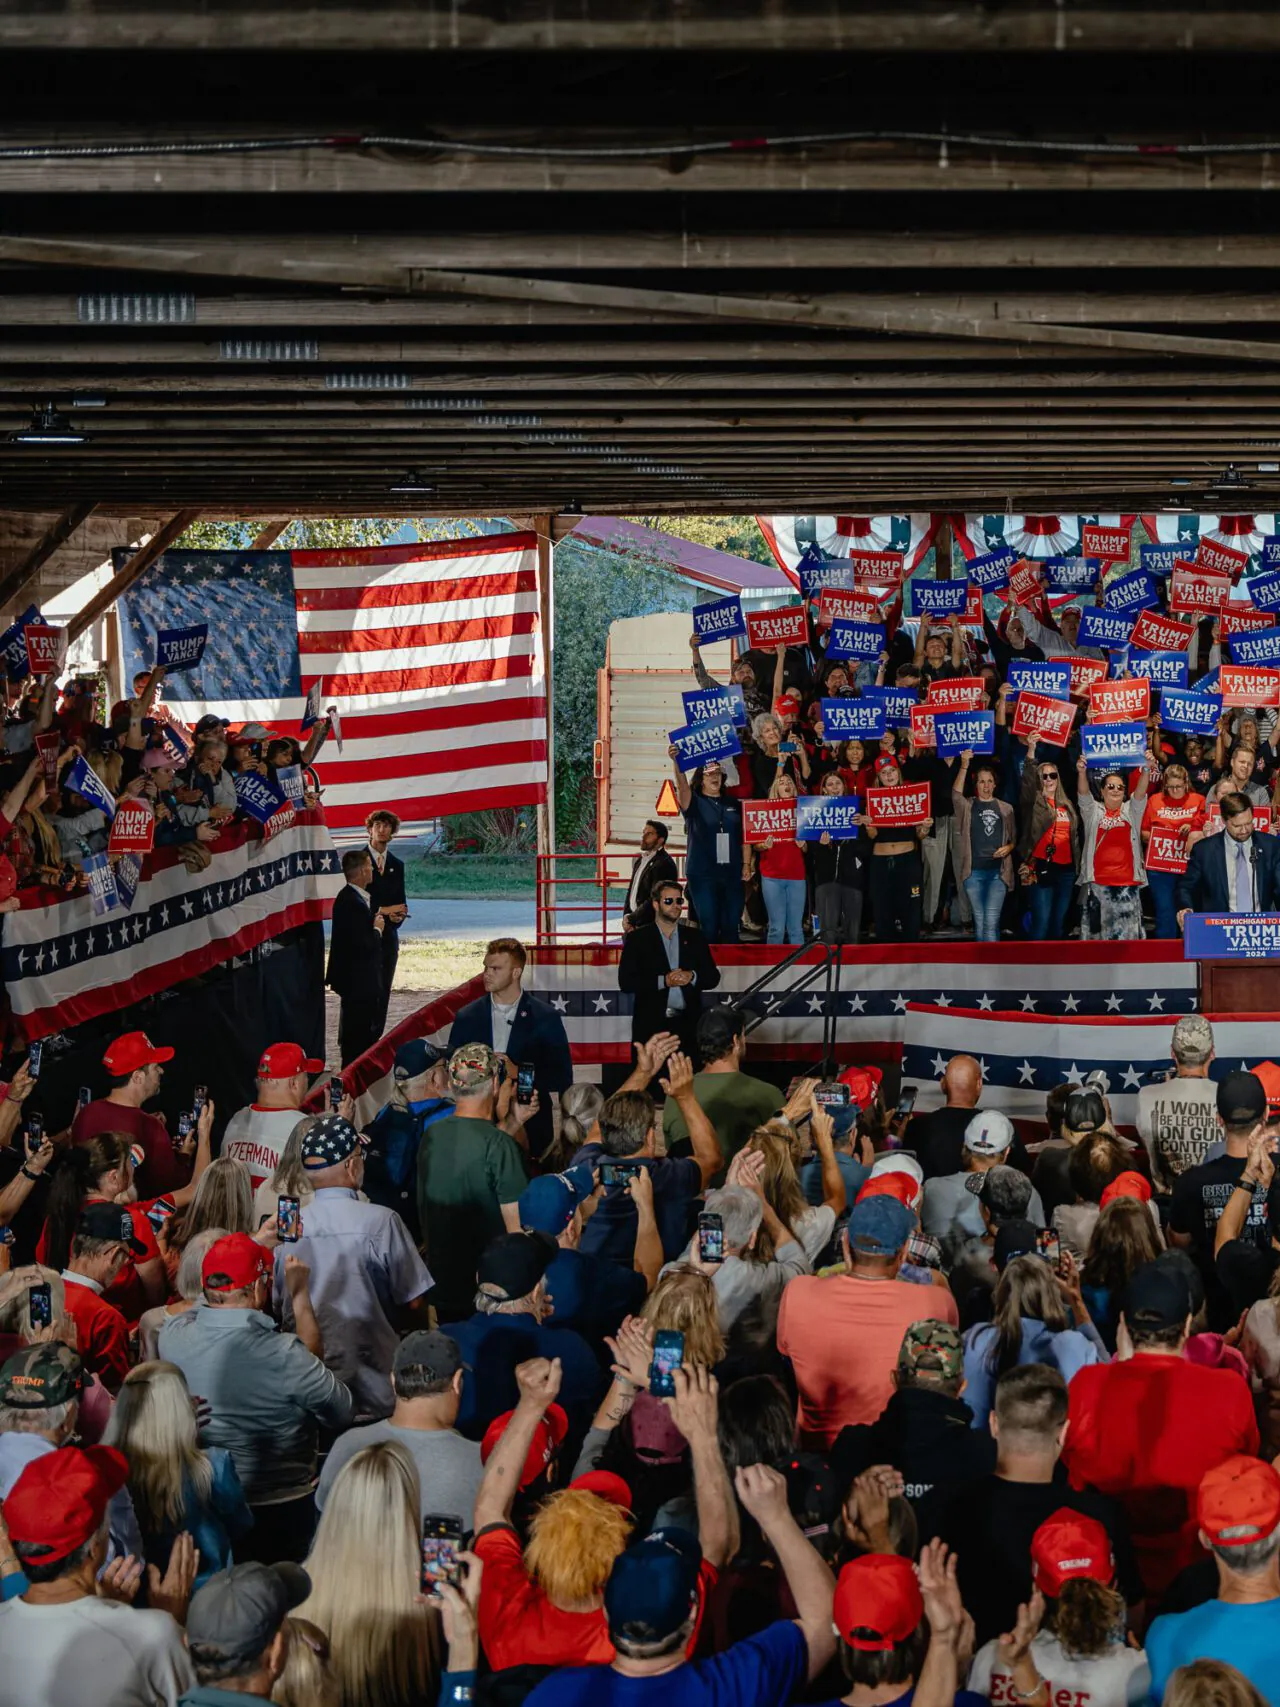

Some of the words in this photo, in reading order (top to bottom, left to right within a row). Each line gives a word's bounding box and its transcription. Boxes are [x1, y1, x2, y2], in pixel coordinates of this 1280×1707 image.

[1085, 534, 1128, 545] TRUMP
[1089, 543, 1122, 552] VANCE
[1144, 551, 1191, 561] TRUMP
[1201, 546, 1243, 569] TRUMP
[802, 568, 850, 579] TRUMP
[857, 566, 894, 577] VANCE
[968, 556, 1013, 579] TRUMP
[1049, 566, 1096, 576] TRUMP
[807, 577, 845, 587] VANCE
[1010, 568, 1029, 587] TRUMP
[1053, 574, 1090, 583] VANCE
[1013, 578, 1033, 593] VANCE
[1176, 583, 1227, 596] TRUMP
[915, 588, 964, 600] TRUMP
[1109, 588, 1147, 608] VANCE
[1181, 592, 1220, 603] VANCE
[823, 597, 880, 612] TRUMP
[920, 597, 959, 606] VANCE
[695, 606, 738, 625] TRUMP
[829, 608, 867, 620] VANCE
[1222, 614, 1272, 627] TRUMP
[700, 617, 735, 631] VANCE
[751, 615, 803, 630] TRUMP
[1086, 617, 1134, 631] TRUMP
[757, 625, 798, 637] VANCE
[834, 629, 883, 642] TRUMP
[1089, 626, 1127, 639] VANCE
[1141, 619, 1189, 641] TRUMP
[161, 636, 204, 652] TRUMP
[838, 639, 878, 651] VANCE
[1143, 631, 1181, 647] VANCE
[167, 647, 198, 661] VANCE
[1240, 648, 1278, 660] VANCE
[1131, 661, 1184, 671] TRUMP
[1011, 671, 1067, 682] TRUMP
[1135, 669, 1178, 679] VANCE
[1223, 674, 1278, 686] TRUMP
[1016, 680, 1060, 690] VANCE
[1229, 684, 1272, 694] VANCE
[930, 687, 982, 701] TRUMP
[1093, 688, 1147, 703] TRUMP
[687, 695, 740, 712] TRUMP
[1100, 698, 1141, 711] VANCE
[1165, 698, 1218, 713] TRUMP
[825, 708, 881, 718] TRUMP
[1020, 701, 1070, 722] TRUMP
[1169, 709, 1211, 722] VANCE
[832, 718, 876, 726] VANCE
[937, 721, 990, 734] TRUMP
[1022, 714, 1061, 731] VANCE
[675, 724, 730, 748] TRUMP
[944, 731, 984, 742] VANCE
[1085, 732, 1143, 744] TRUMP
[684, 737, 729, 755] VANCE
[1092, 743, 1137, 753] VANCE
[870, 792, 927, 807] TRUMP
[801, 807, 856, 817] TRUMP
[877, 801, 921, 814] VANCE
[807, 817, 849, 826] VANCE
[115, 824, 147, 835] VANCE
[1230, 937, 1280, 947] VANCE
[1161, 1101, 1164, 1114] I
[1171, 1101, 1216, 1116] WON'
[1160, 1115, 1172, 1125] BE
[1176, 1116, 1216, 1127] LECTUR
[1160, 1126, 1184, 1140] ON
[1190, 1127, 1226, 1141] GUN
[1160, 1140, 1208, 1153] CONTR
[228, 1142, 278, 1169] YZERMAN
[11, 1375, 44, 1386] TRUMP
[1058, 1558, 1091, 1570] TRUMP
